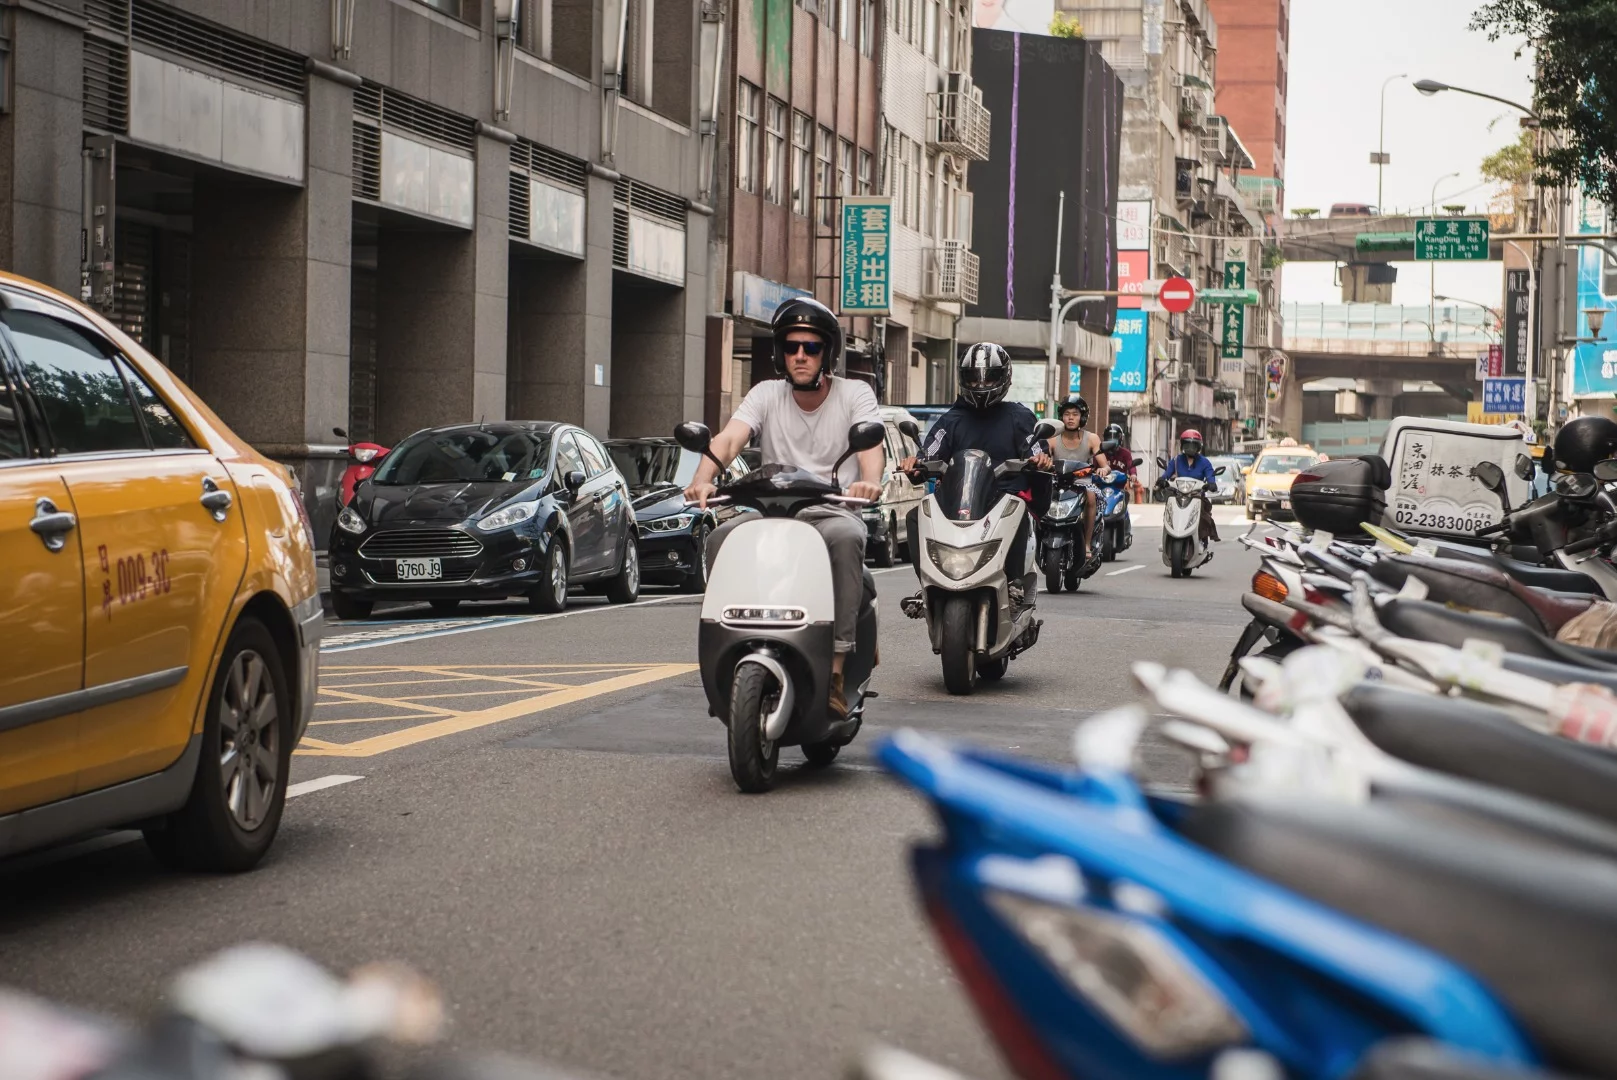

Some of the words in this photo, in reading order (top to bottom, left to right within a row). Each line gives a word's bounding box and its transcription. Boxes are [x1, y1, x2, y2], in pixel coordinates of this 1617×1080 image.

[1423, 221, 1481, 235] 康定路
[1425, 236, 1460, 244] KangDing
[860, 207, 888, 306] 套房出租
[1114, 319, 1143, 334] 務所
[1110, 371, 1142, 386] -493
[117, 548, 171, 605] 009-3C
[397, 562, 440, 576] 9760-J9
